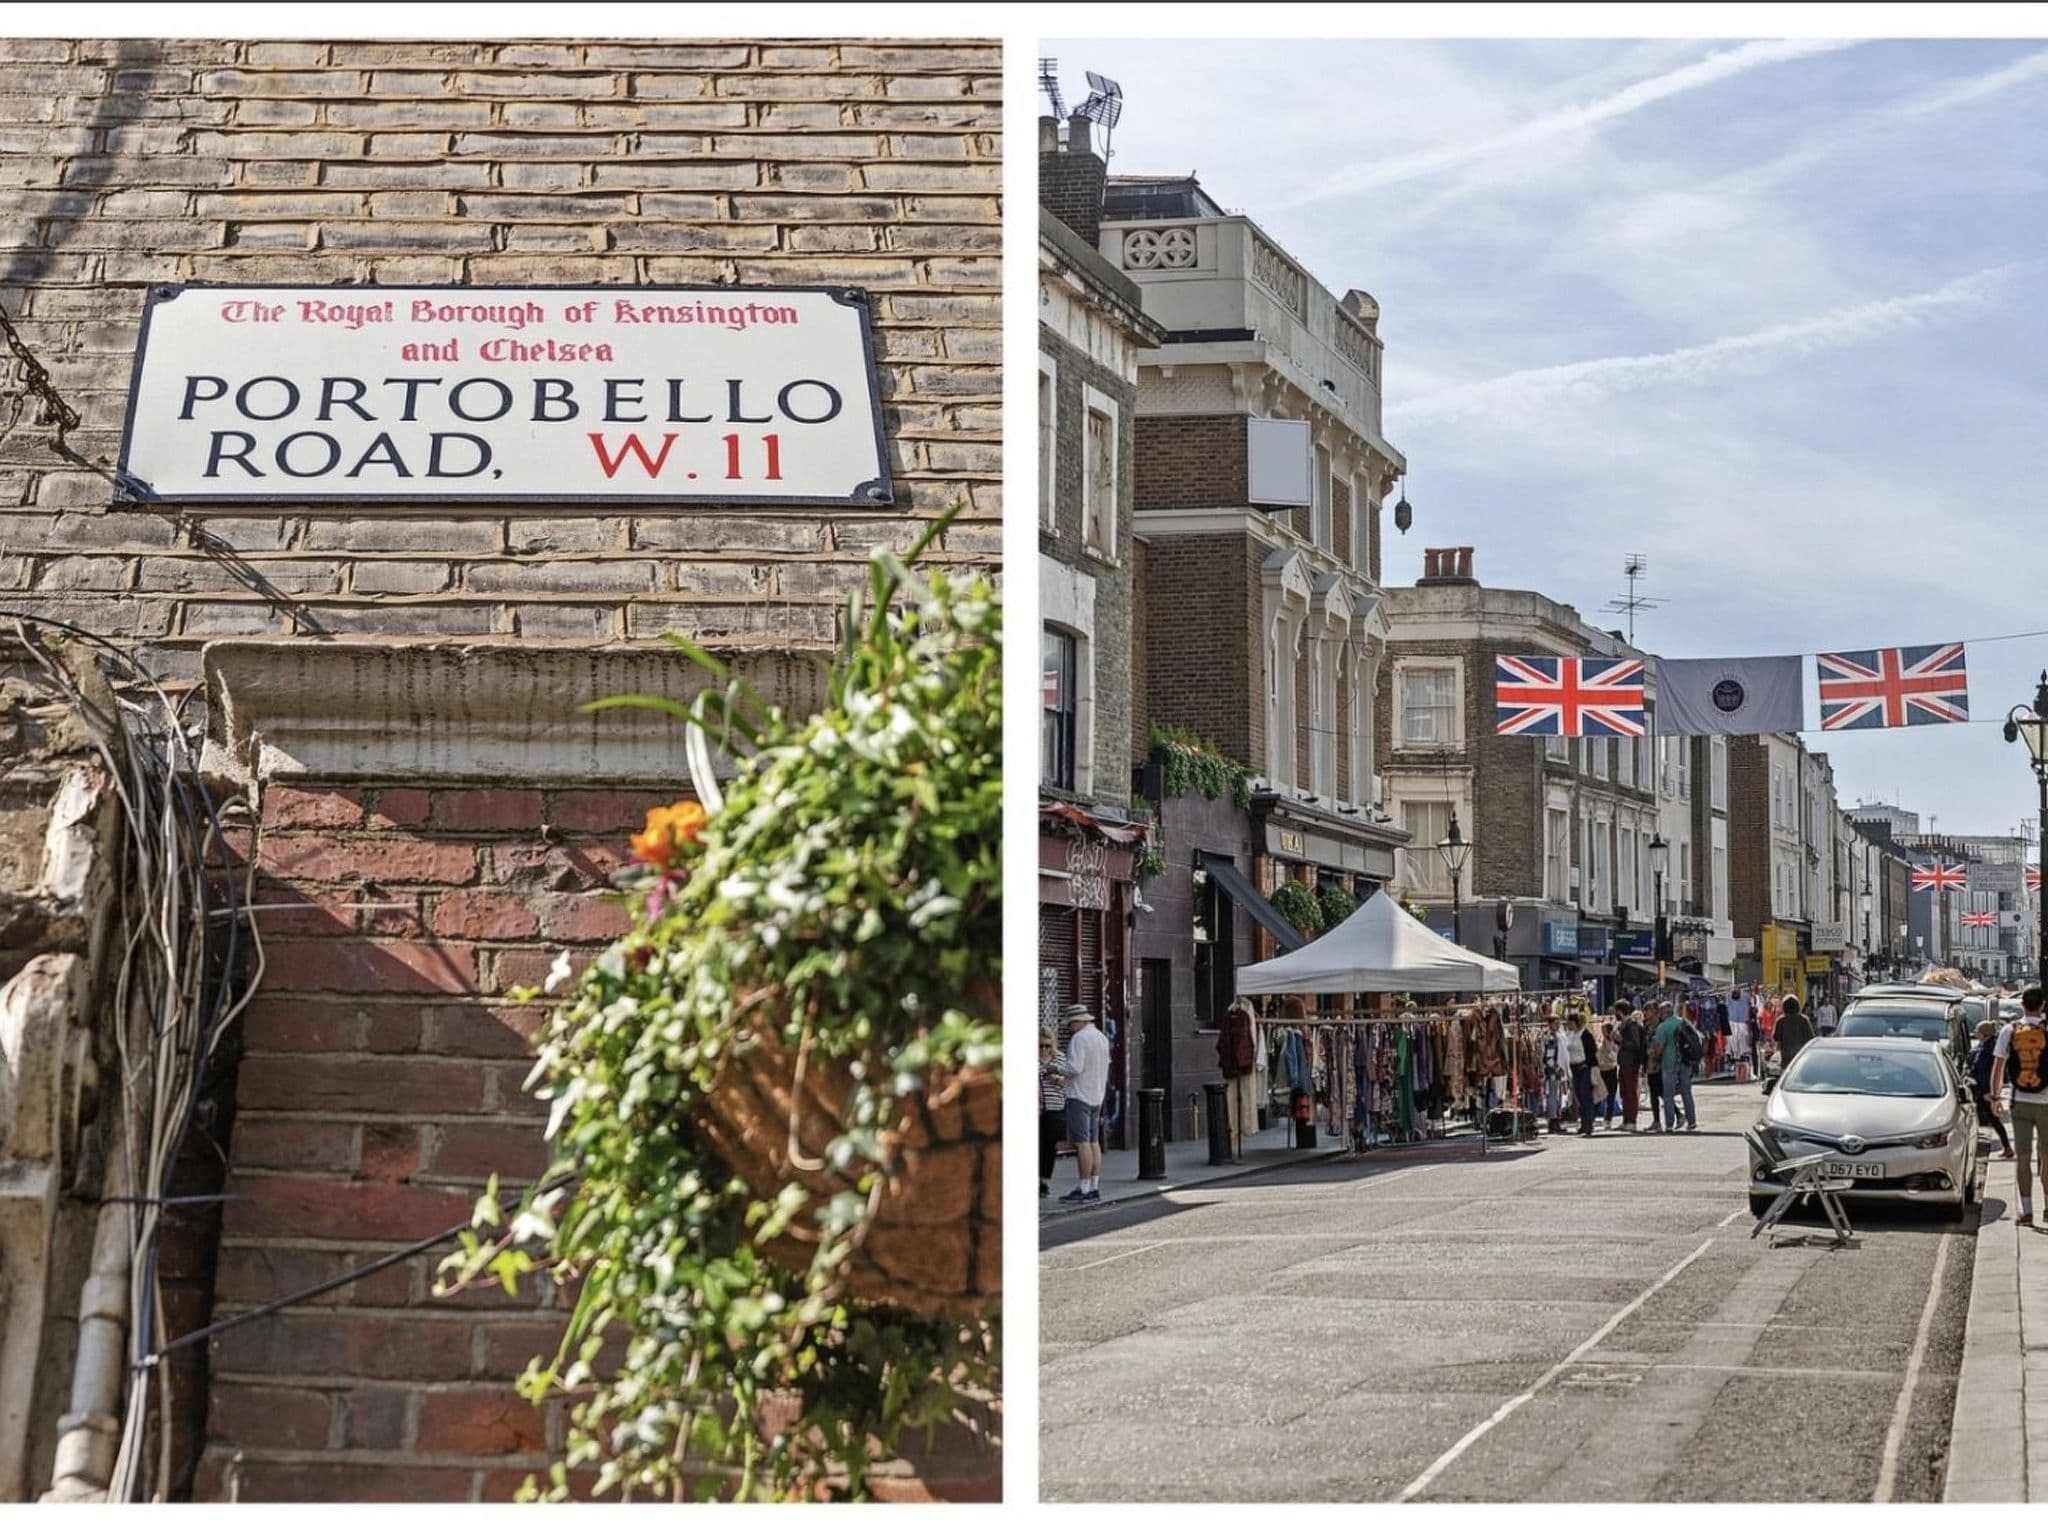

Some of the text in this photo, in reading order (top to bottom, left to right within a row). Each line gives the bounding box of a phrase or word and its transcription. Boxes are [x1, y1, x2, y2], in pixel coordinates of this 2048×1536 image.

[220, 300, 800, 333] The Royal Borough of Kensington
[401, 338, 615, 363] and Chelsea
[177, 375, 844, 426] PORTOBELLO
[201, 430, 504, 481] ROAD,
